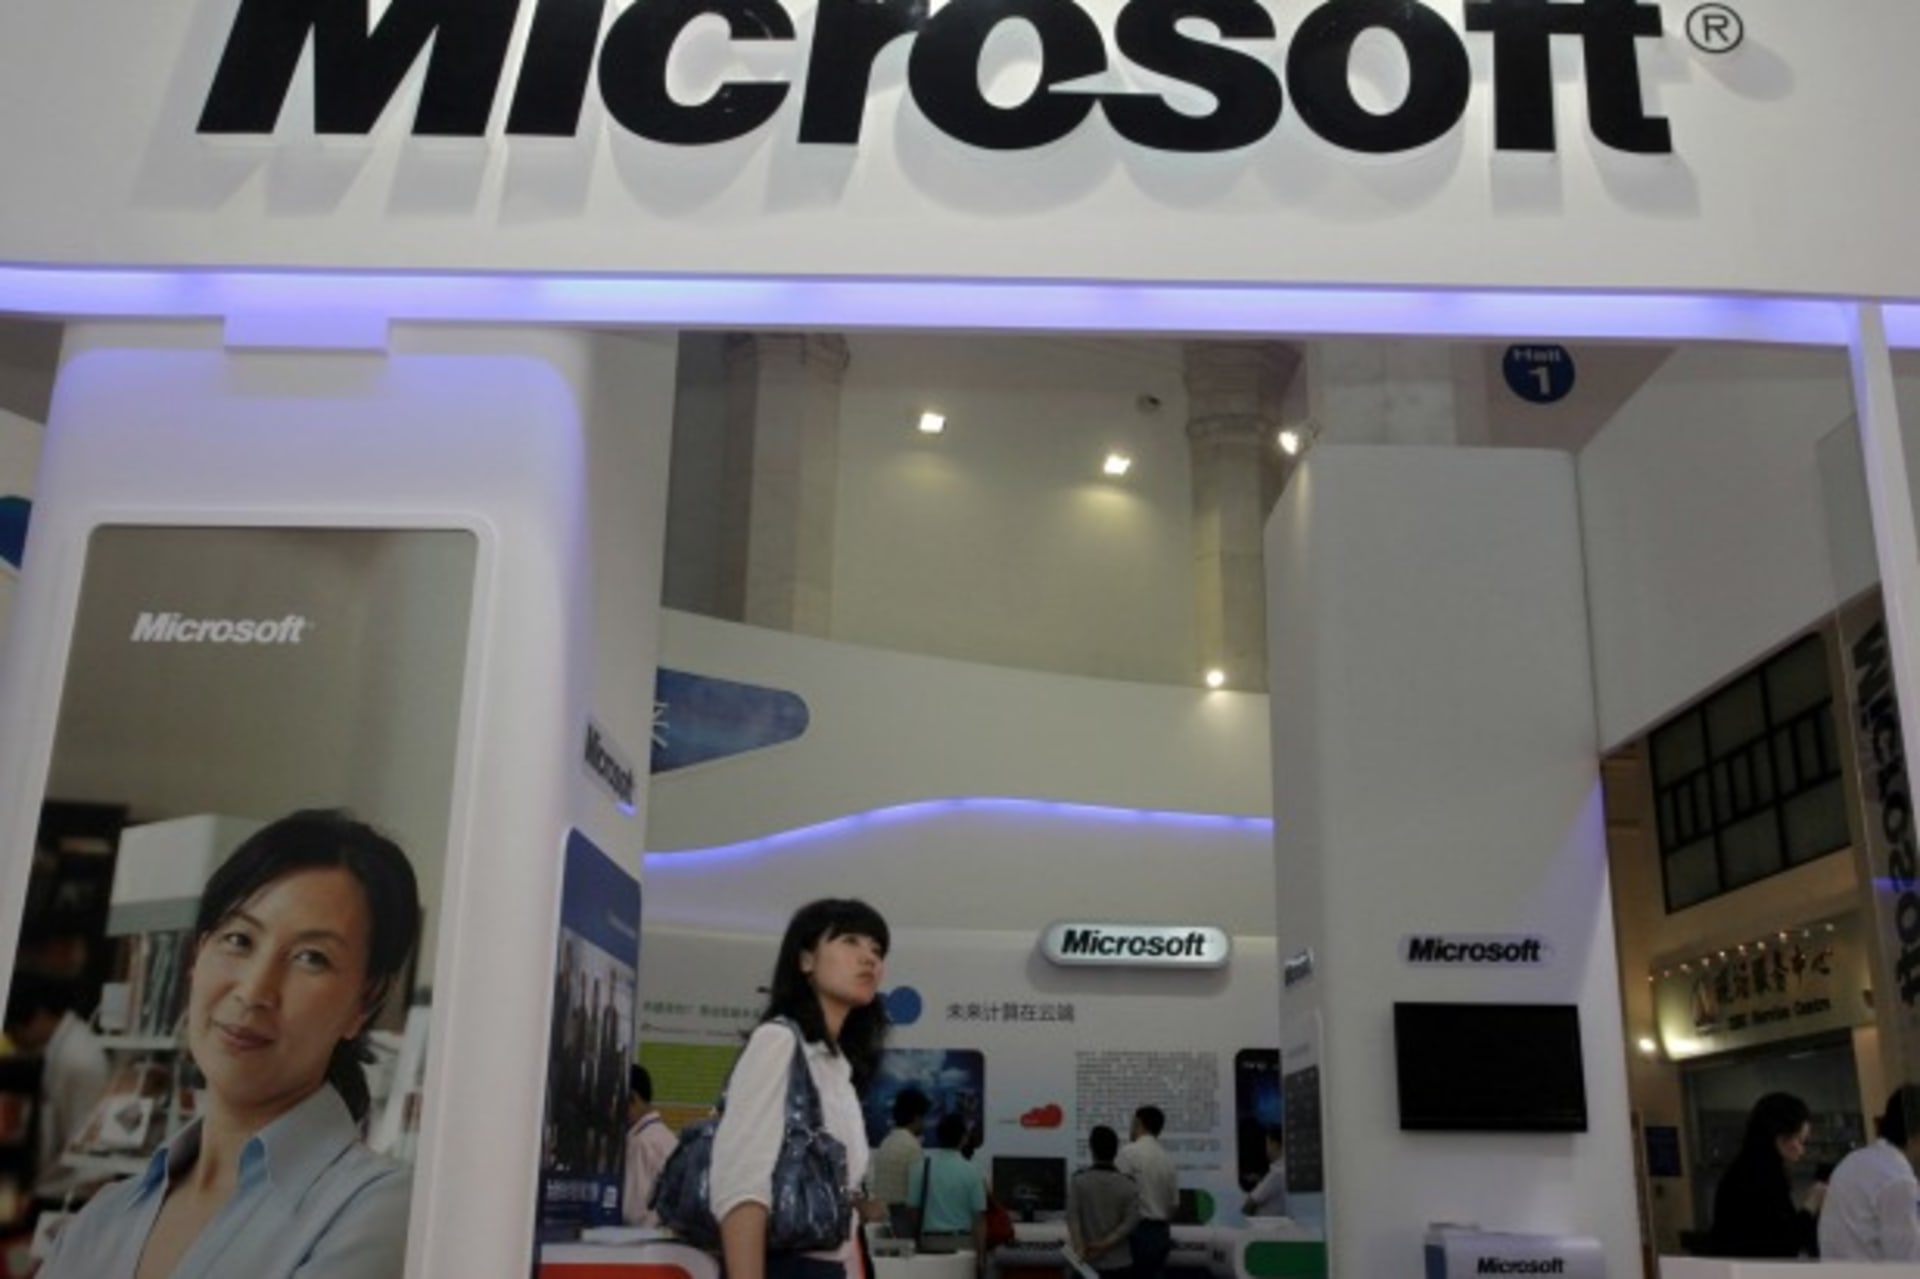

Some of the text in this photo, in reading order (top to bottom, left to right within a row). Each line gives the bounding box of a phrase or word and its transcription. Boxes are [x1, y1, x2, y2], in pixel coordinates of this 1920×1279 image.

[195, 0, 1672, 153] Microsoft
[1528, 365, 1551, 395] 1
[131, 612, 307, 643] Microsoft
[1061, 929, 1205, 957] Microsoft
[1408, 937, 1541, 963] Microsoft
[1477, 1256, 1564, 1274] Microsoft
